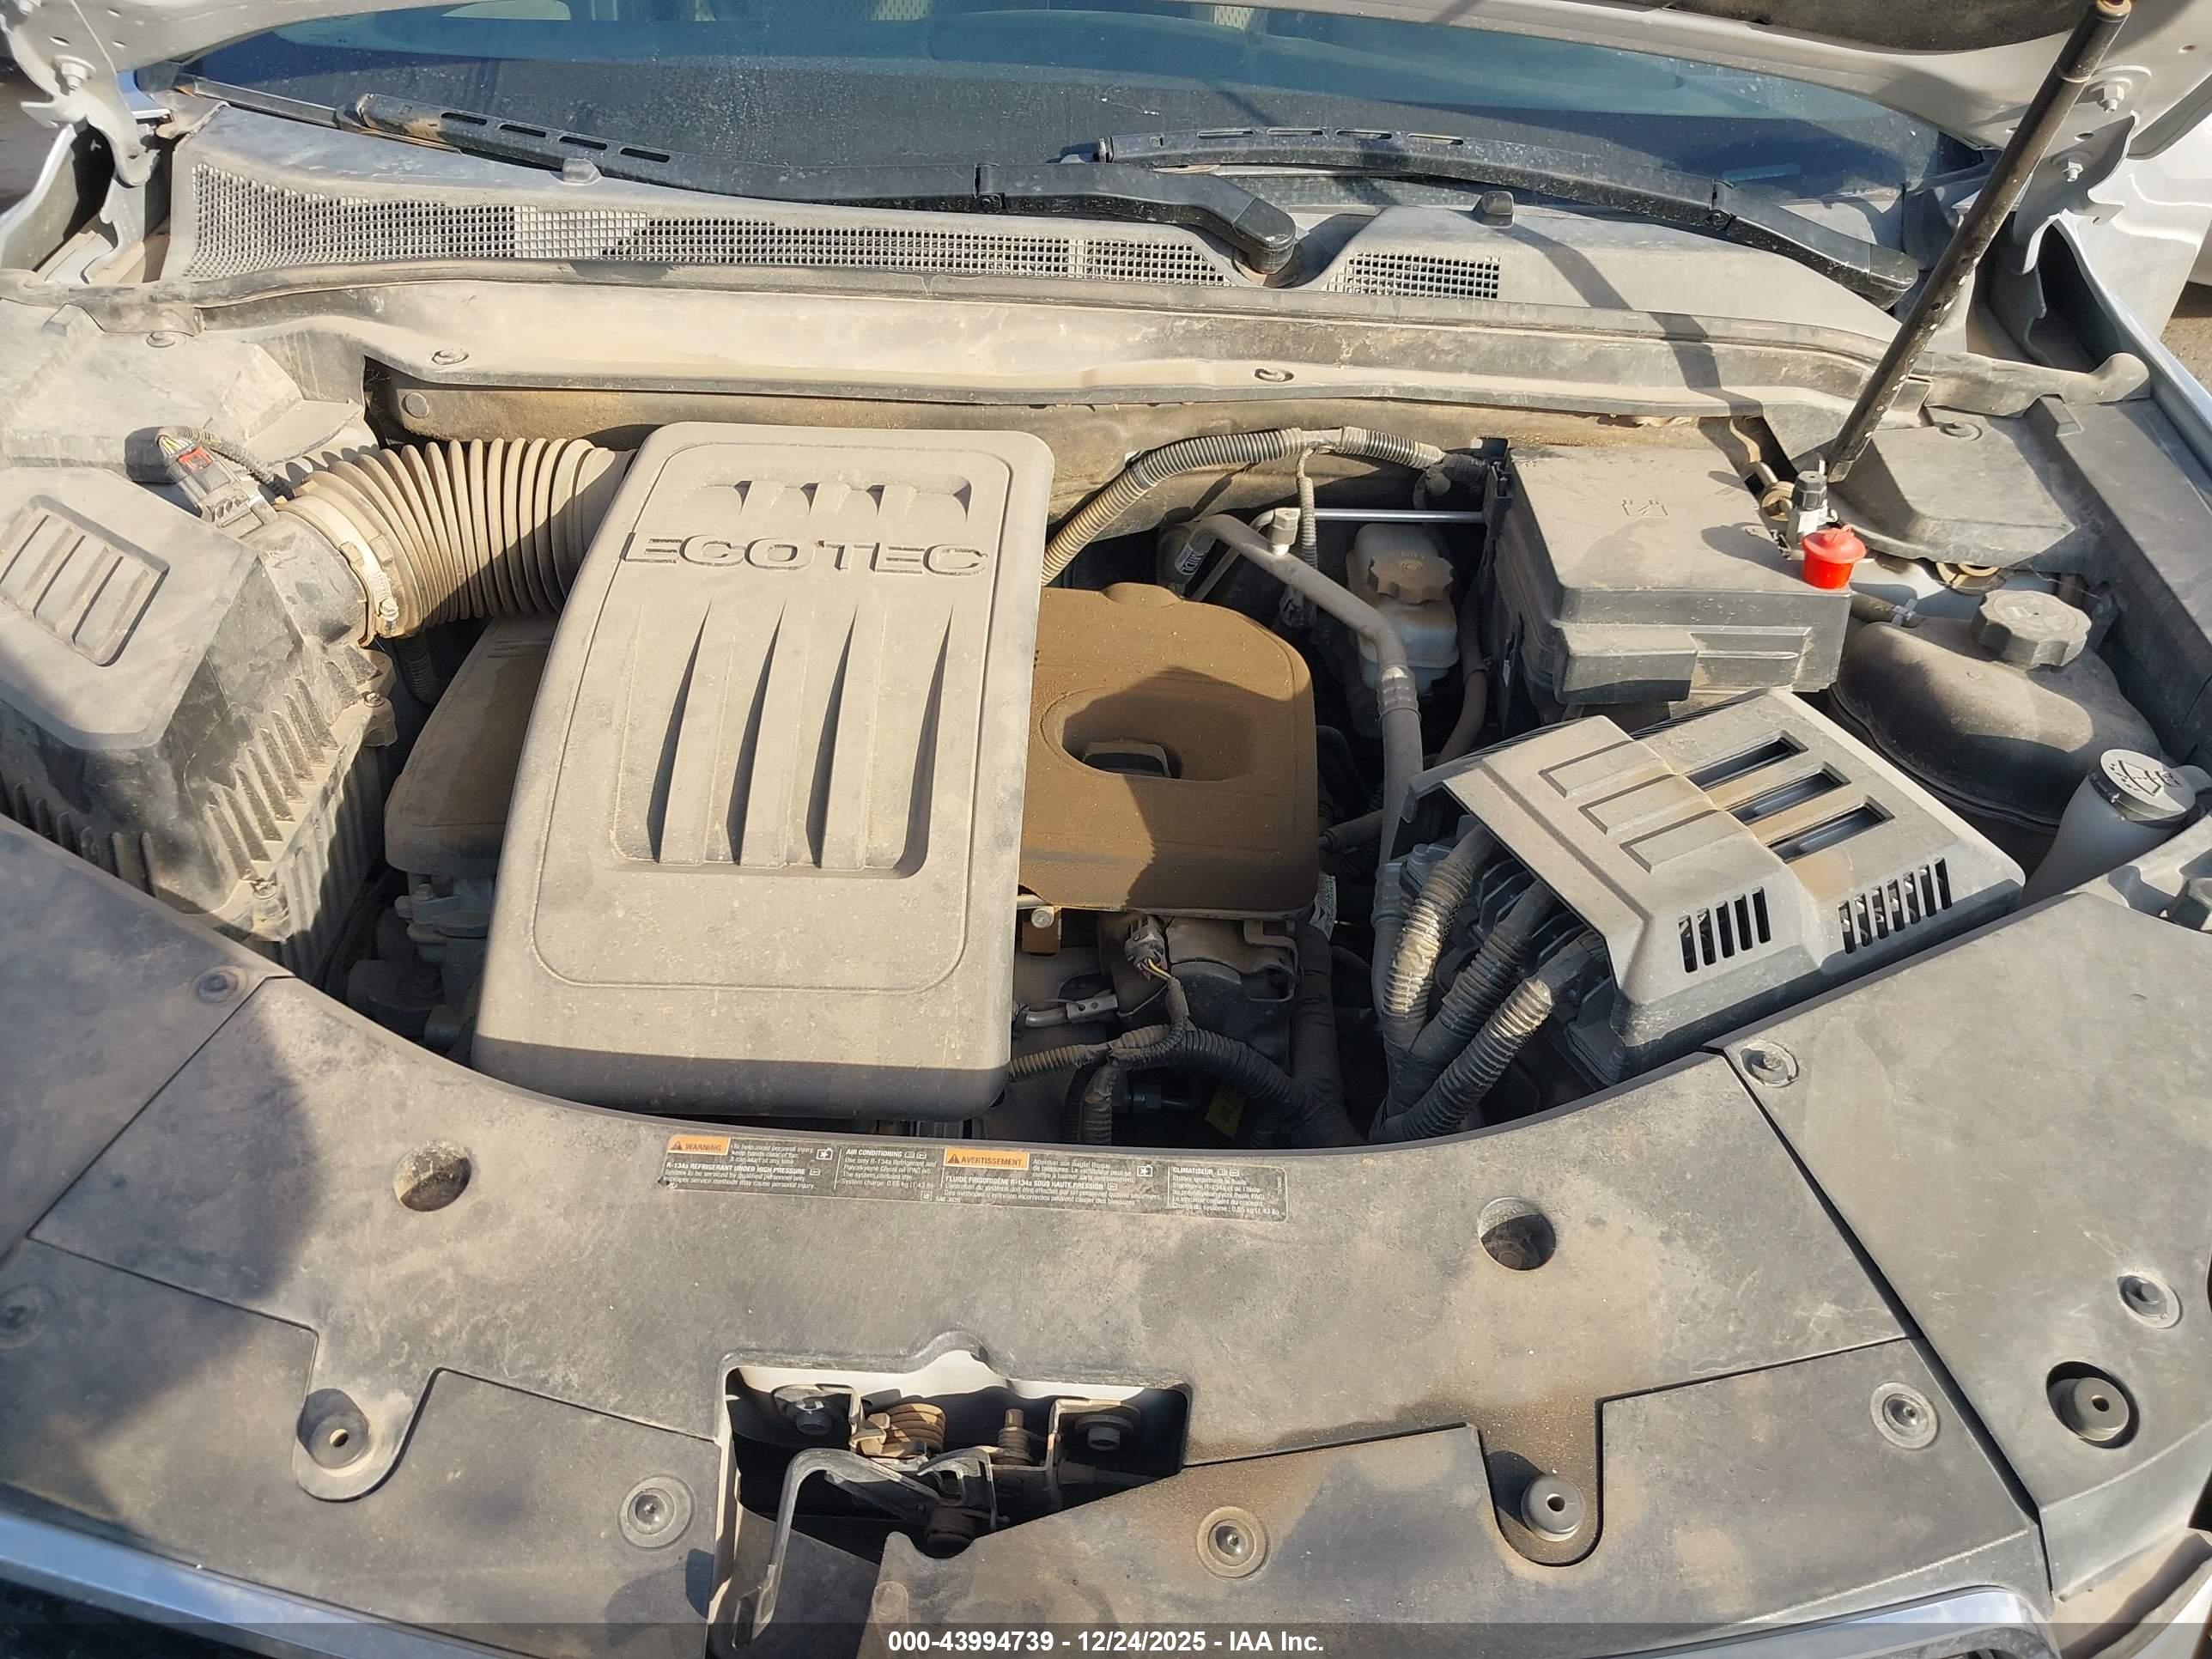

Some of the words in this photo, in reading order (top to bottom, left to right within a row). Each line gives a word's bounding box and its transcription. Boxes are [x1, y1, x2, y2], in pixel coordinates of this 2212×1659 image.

[620, 532, 989, 577] ECOTEC
[686, 1142, 721, 1152] WARNING
[961, 1156, 1023, 1166] AVERTISSEMENT
[690, 1163, 732, 1171] REFRIGERANT
[1173, 1166, 1213, 1175] CLIMATISEUR
